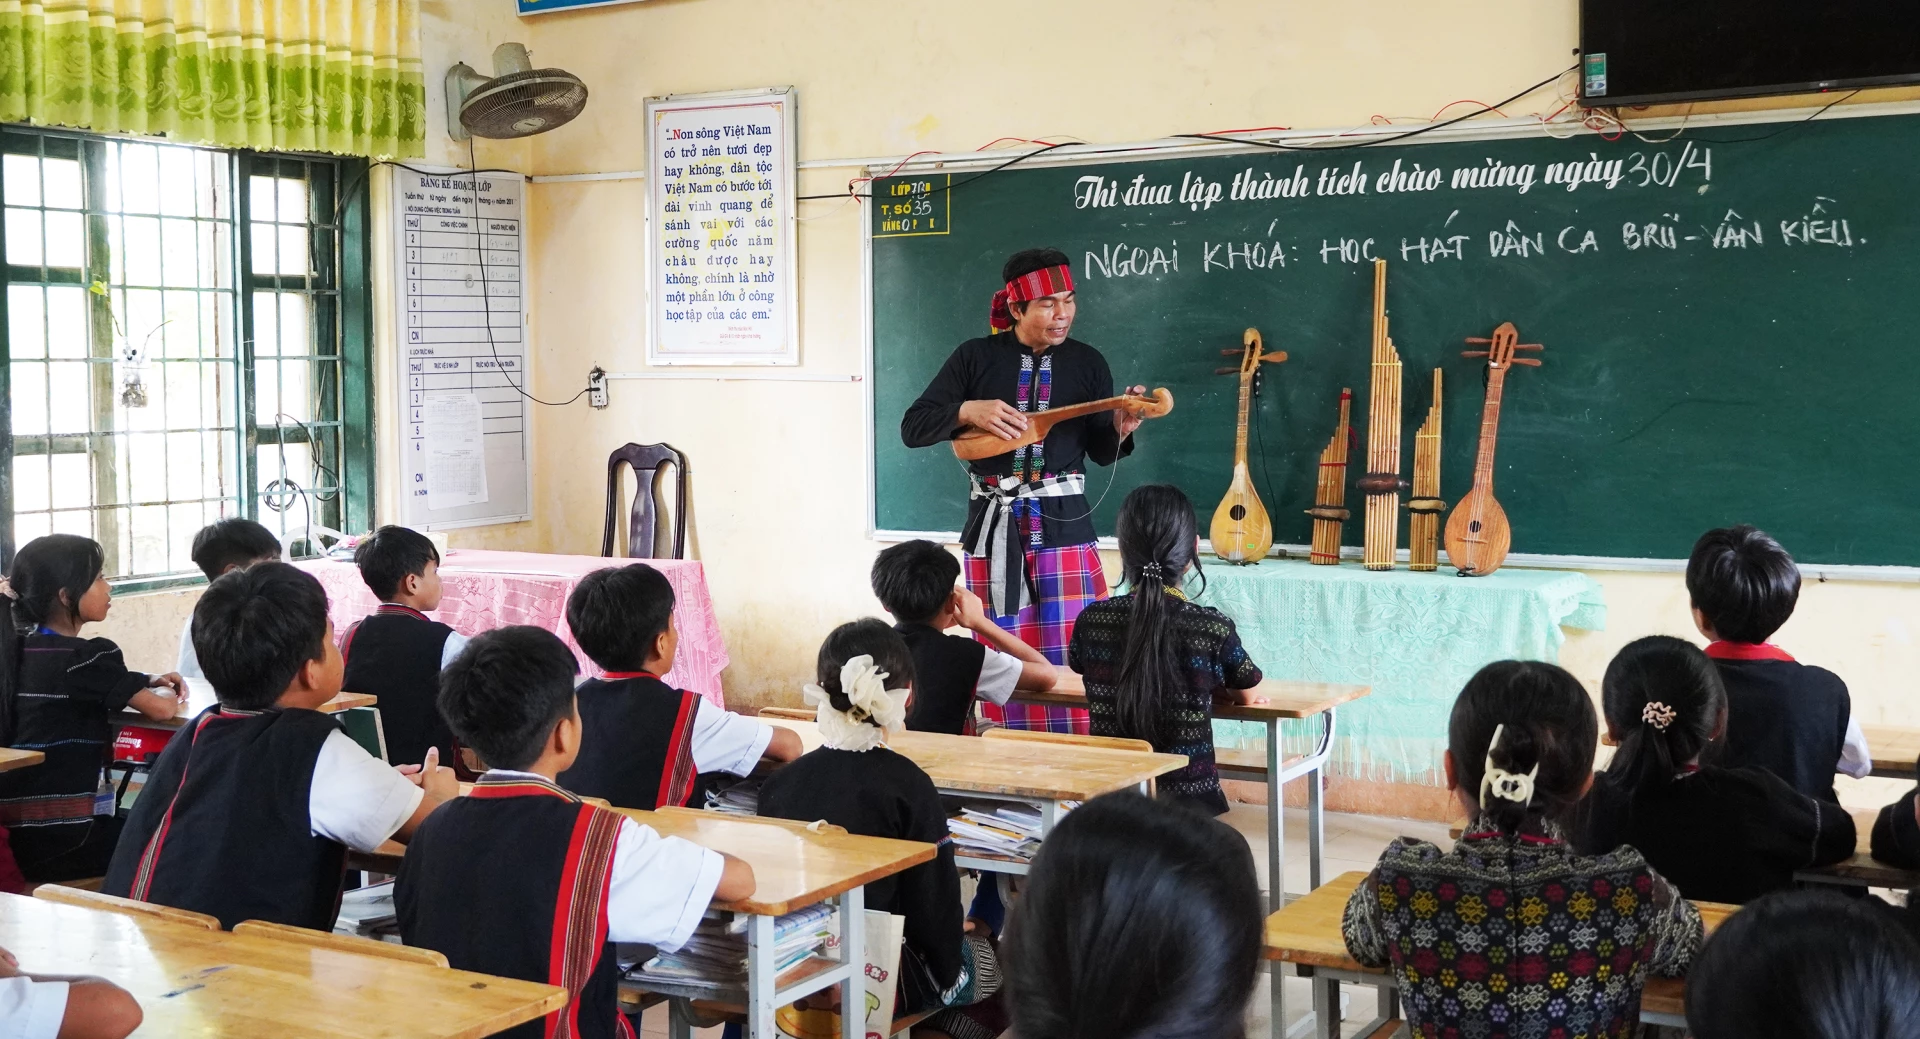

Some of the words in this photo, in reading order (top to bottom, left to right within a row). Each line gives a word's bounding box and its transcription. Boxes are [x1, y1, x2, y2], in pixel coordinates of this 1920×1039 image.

[695, 127, 720, 140] sông
[723, 125, 744, 139] Việt
[747, 124, 771, 135] Nam
[664, 147, 675, 158] có
[681, 144, 697, 157] trở
[702, 145, 721, 156] nên
[727, 144, 747, 155] tươi
[753, 143, 772, 156] đẹp
[664, 166, 683, 179] hay
[689, 163, 725, 177] không,
[731, 162, 750, 173] dân
[757, 160, 772, 174] tộc
[1074, 174, 1118, 210] Thi
[1125, 173, 1173, 206] đua
[1179, 170, 1224, 211] lập
[1230, 164, 1310, 201] thành
[1316, 160, 1366, 196] tích
[1376, 158, 1444, 194] chào
[1451, 157, 1537, 194] mừng
[1544, 152, 1625, 193] ngày
[1628, 141, 1712, 188] 30/4
[453, 180, 476, 192] HOẠCH
[478, 179, 491, 192] LỚP
[665, 183, 685, 197] Việt
[688, 183, 712, 193] Nam
[715, 181, 727, 192] có
[730, 179, 755, 191] bước
[758, 179, 772, 190] tới
[891, 181, 911, 196] LỚP
[664, 201, 680, 212] đài
[688, 201, 712, 211] vinh
[720, 201, 753, 213] quang
[761, 193, 774, 209] để
[894, 199, 912, 215] SỐ
[912, 200, 932, 216] 35
[665, 219, 690, 230] sánh
[701, 219, 717, 229] vai
[727, 217, 744, 228] với
[755, 216, 773, 228] các
[411, 235, 415, 243] 2
[665, 237, 700, 250] cường
[710, 234, 738, 250] quốc
[748, 235, 773, 246] năm
[1399, 209, 1470, 265] HÁT
[1489, 219, 1544, 259] DÂN
[1557, 225, 1599, 253] CA
[411, 251, 415, 259] 3
[665, 255, 696, 266] châu
[707, 255, 738, 268] được
[750, 254, 773, 267] hay
[411, 267, 416, 275] 4
[665, 272, 701, 286] không,
[705, 272, 734, 283] chính
[739, 271, 749, 283] là
[754, 271, 775, 283] nhờ
[412, 284, 416, 292] 5
[412, 299, 417, 307] 6
[666, 291, 685, 305] một
[689, 289, 715, 304] phần
[718, 290, 735, 301] lớn
[739, 288, 745, 301] ở
[749, 289, 774, 303] công
[413, 315, 417, 324] 7
[666, 309, 684, 323] học
[686, 309, 702, 323] tập
[707, 306, 725, 320] của
[730, 308, 747, 320] các
[411, 331, 419, 340] CN
[415, 378, 419, 387] 2
[415, 394, 419, 402] 3
[415, 410, 419, 418] 4
[416, 426, 420, 435] 5
[416, 442, 420, 450] 6
[415, 473, 423, 482] CN
